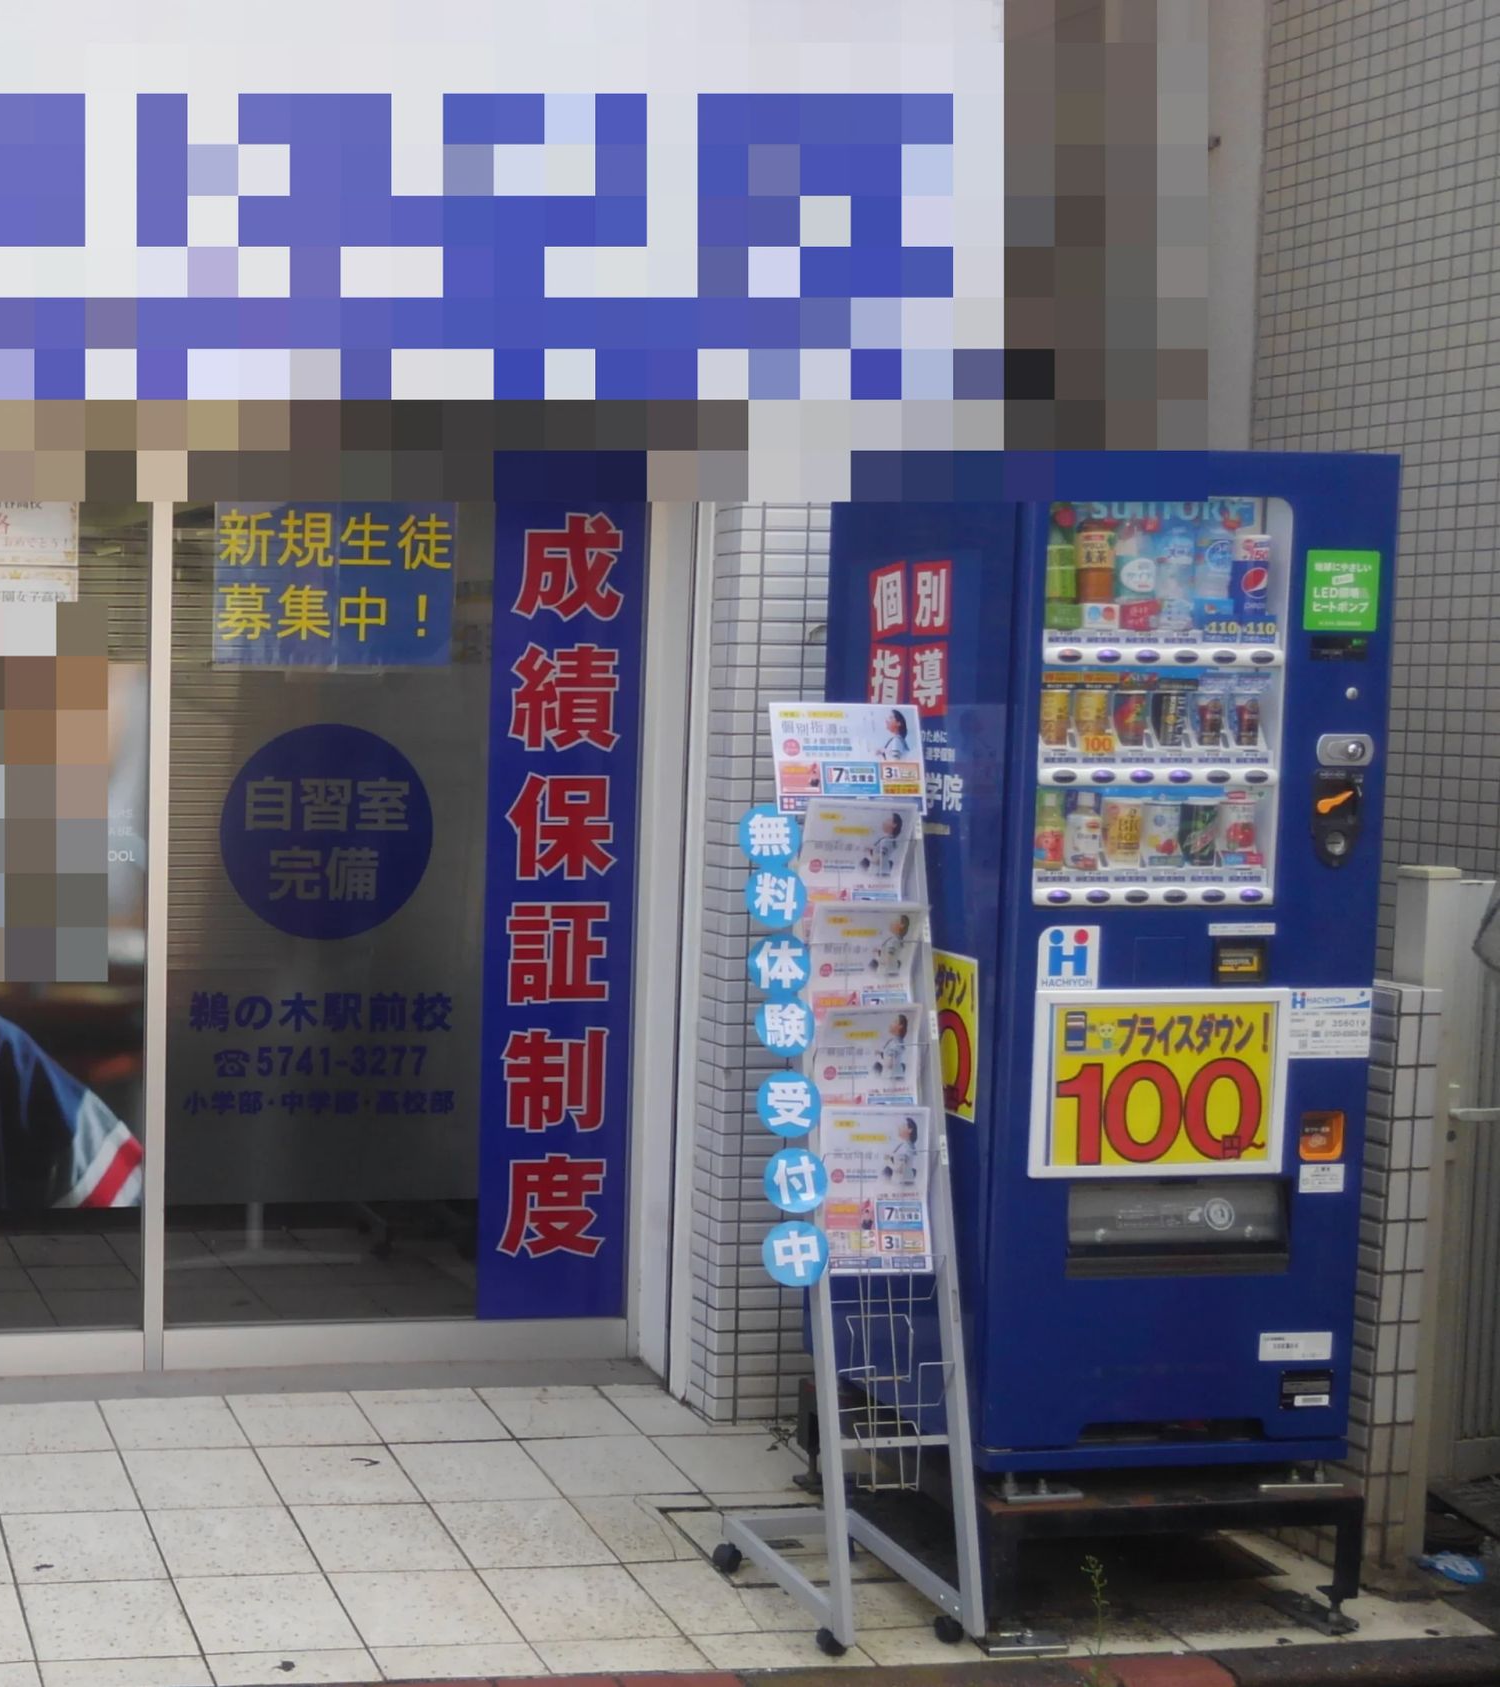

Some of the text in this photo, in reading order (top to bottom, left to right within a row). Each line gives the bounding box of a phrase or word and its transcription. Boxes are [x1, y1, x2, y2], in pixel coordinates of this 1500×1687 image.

[218, 508, 453, 570] 新規生徒
[873, 568, 947, 632] 個別
[871, 648, 944, 708] 指導
[244, 776, 410, 832] 自習室
[268, 847, 380, 902] 完備
[497, 512, 624, 1258] 成績保証制度
[1041, 978, 1093, 987] HACHIYOH
[190, 992, 453, 1032] 鵜の木駅前校
[257, 1047, 428, 1077] 5741-3277
[748, 814, 820, 1277] 無料体験受付中
